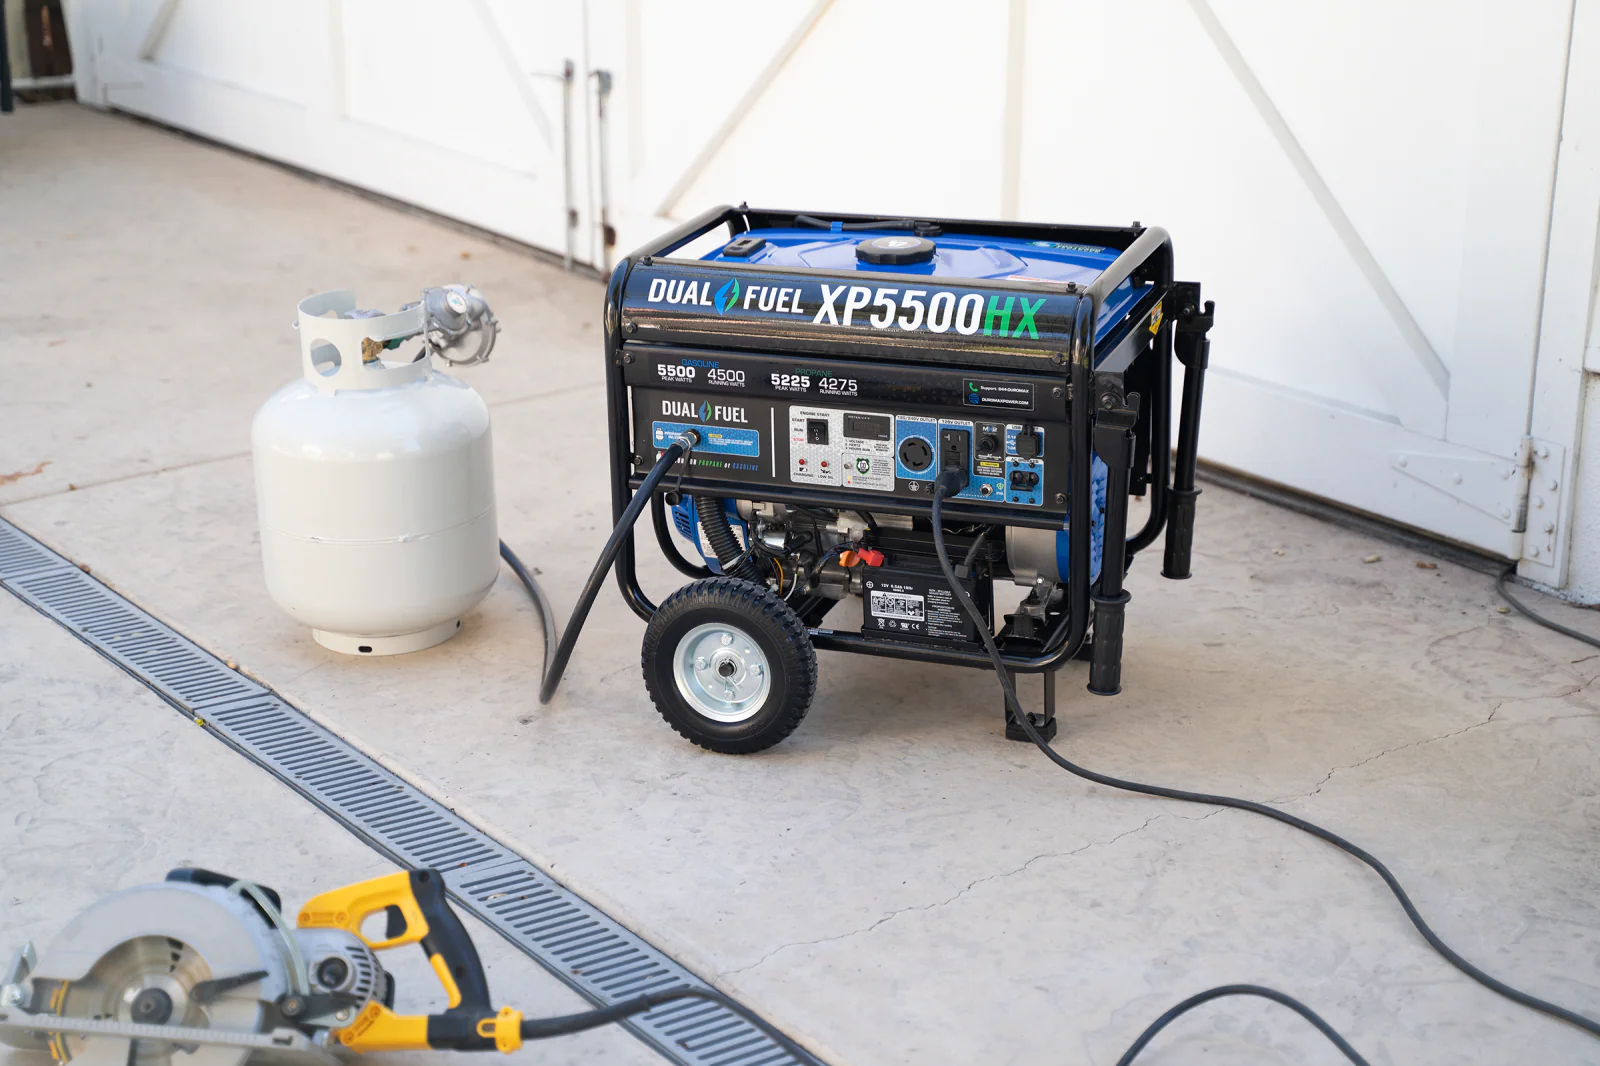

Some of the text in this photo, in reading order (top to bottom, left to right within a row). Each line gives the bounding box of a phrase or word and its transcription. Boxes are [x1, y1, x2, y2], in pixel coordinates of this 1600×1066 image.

[648, 278, 1048, 340] DUAL FUEL XP5500HX
[681, 358, 719, 368] GASOLINE
[657, 364, 745, 382] 5500 4500
[795, 367, 832, 377] PROPANE
[708, 379, 729, 387] RUNNING
[770, 373, 858, 391] 5225 4275
[662, 400, 748, 423] DUAL FUEL
[698, 459, 723, 468] PROPANE
[732, 462, 759, 471] GASOLINE
